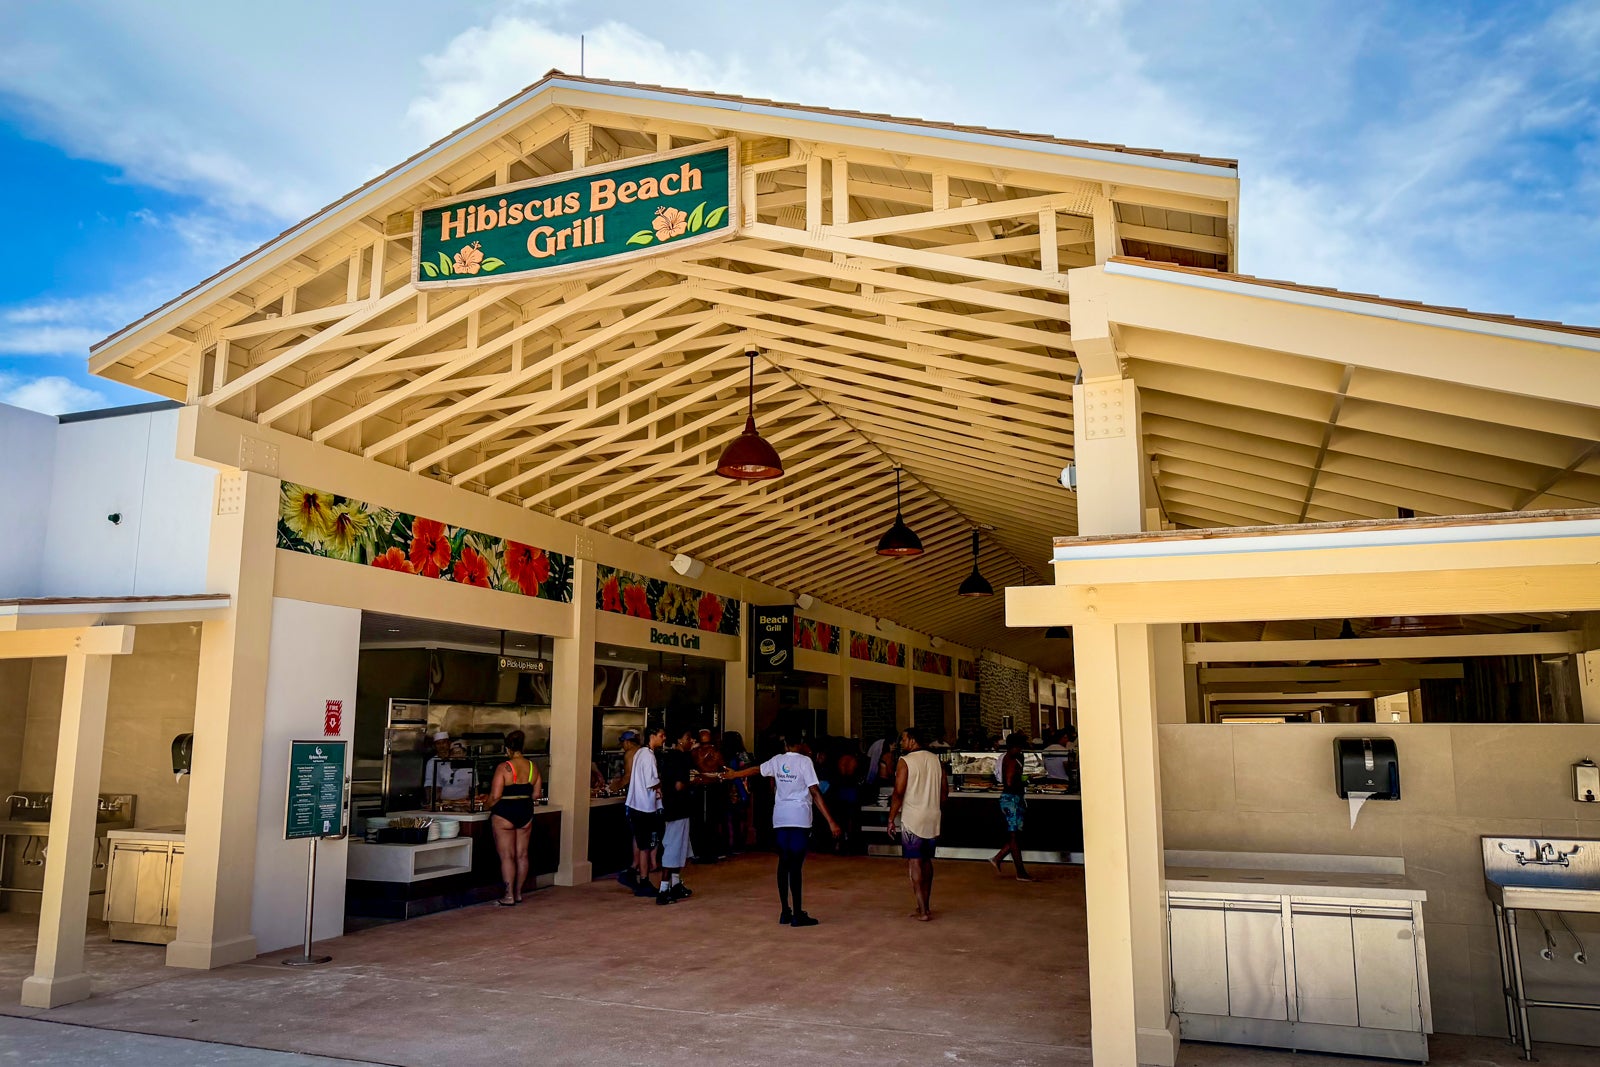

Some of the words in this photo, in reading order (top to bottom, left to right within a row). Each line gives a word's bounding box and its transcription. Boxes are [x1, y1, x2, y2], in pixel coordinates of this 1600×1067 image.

[440, 192, 580, 241] Hibiscus
[589, 163, 702, 212] Beach
[526, 214, 605, 258] Grill
[760, 615, 788, 624] Beach
[766, 624, 782, 632] Grill
[650, 627, 679, 646] Beach
[681, 633, 700, 650] Grill
[527, 662, 538, 670] Here
